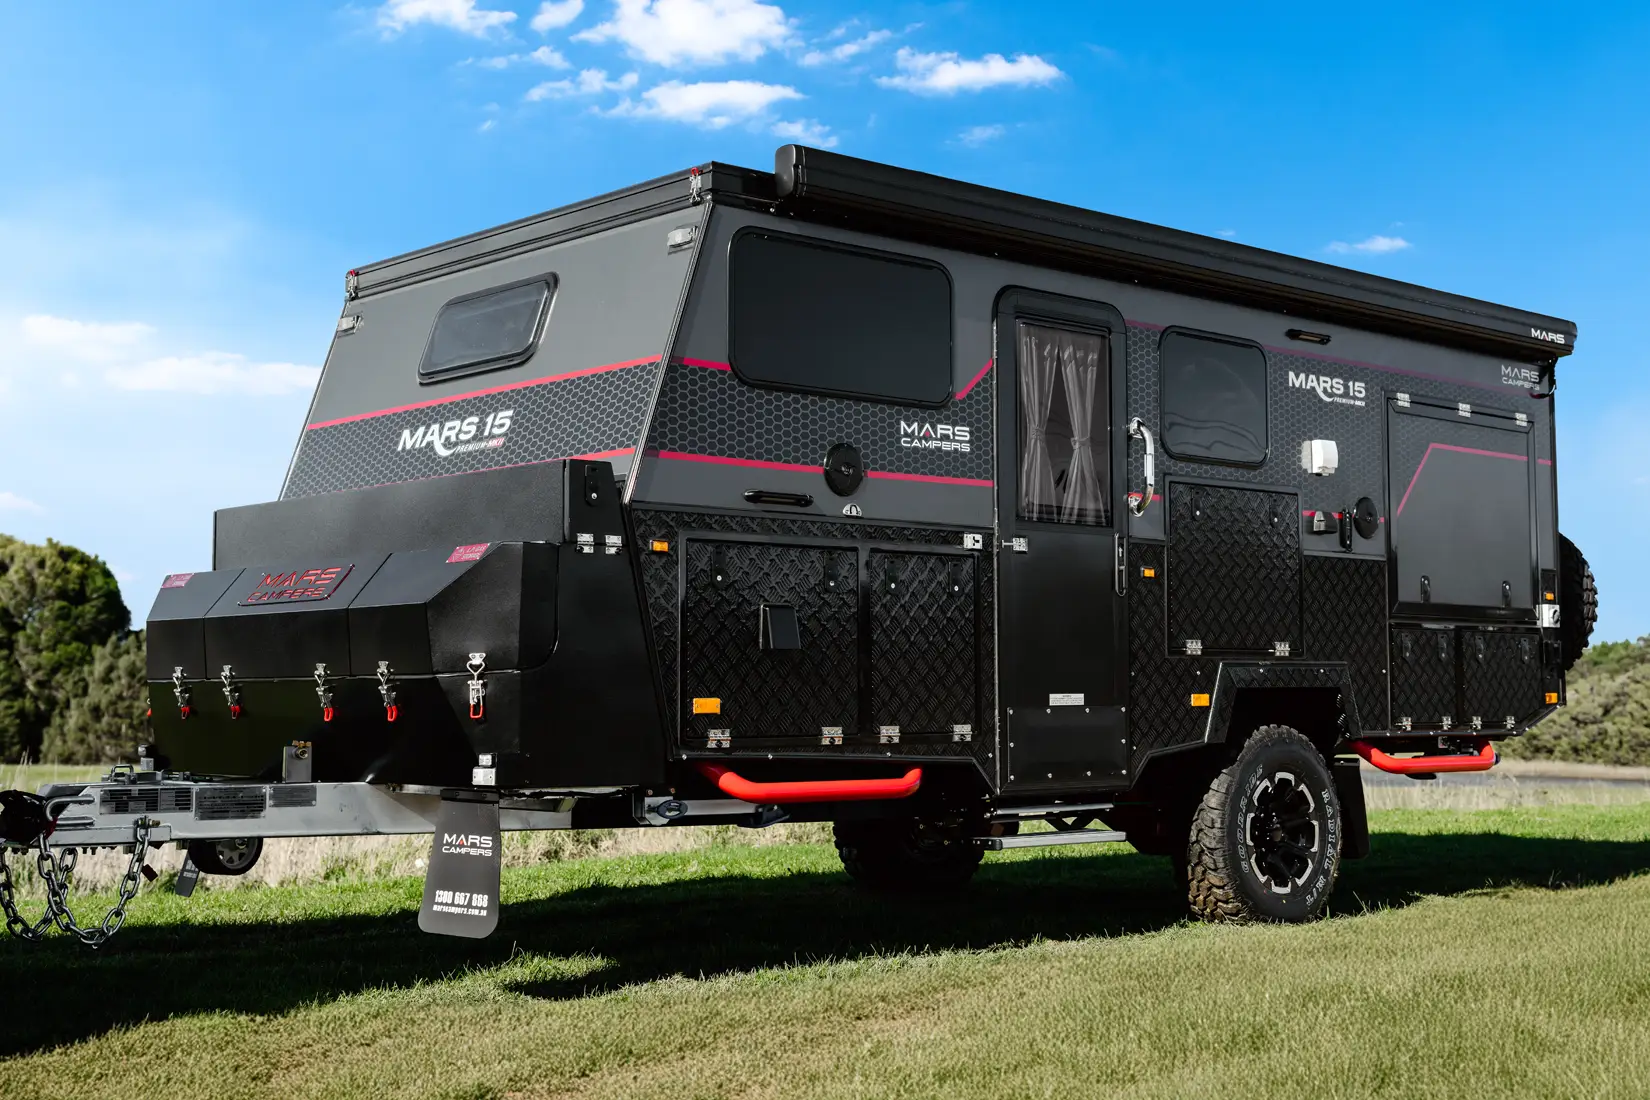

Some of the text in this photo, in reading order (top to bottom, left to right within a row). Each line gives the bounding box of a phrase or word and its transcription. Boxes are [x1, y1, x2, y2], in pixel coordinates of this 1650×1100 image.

[1531, 328, 1565, 344] MARS
[1501, 365, 1540, 382] MARS
[1288, 371, 1366, 401] MARS 15
[1502, 377, 1540, 390] CAMPERS
[397, 410, 514, 456] MARS 15
[900, 420, 970, 440] MARS
[901, 438, 970, 451] CAMPERS
[256, 567, 342, 589] MARS
[247, 587, 326, 603] CAMPERS
[1321, 788, 1336, 870] RADIAL
[443, 833, 492, 848] MARS
[442, 846, 492, 856] CAMPERS
[435, 890, 488, 907] 1300 667 868
